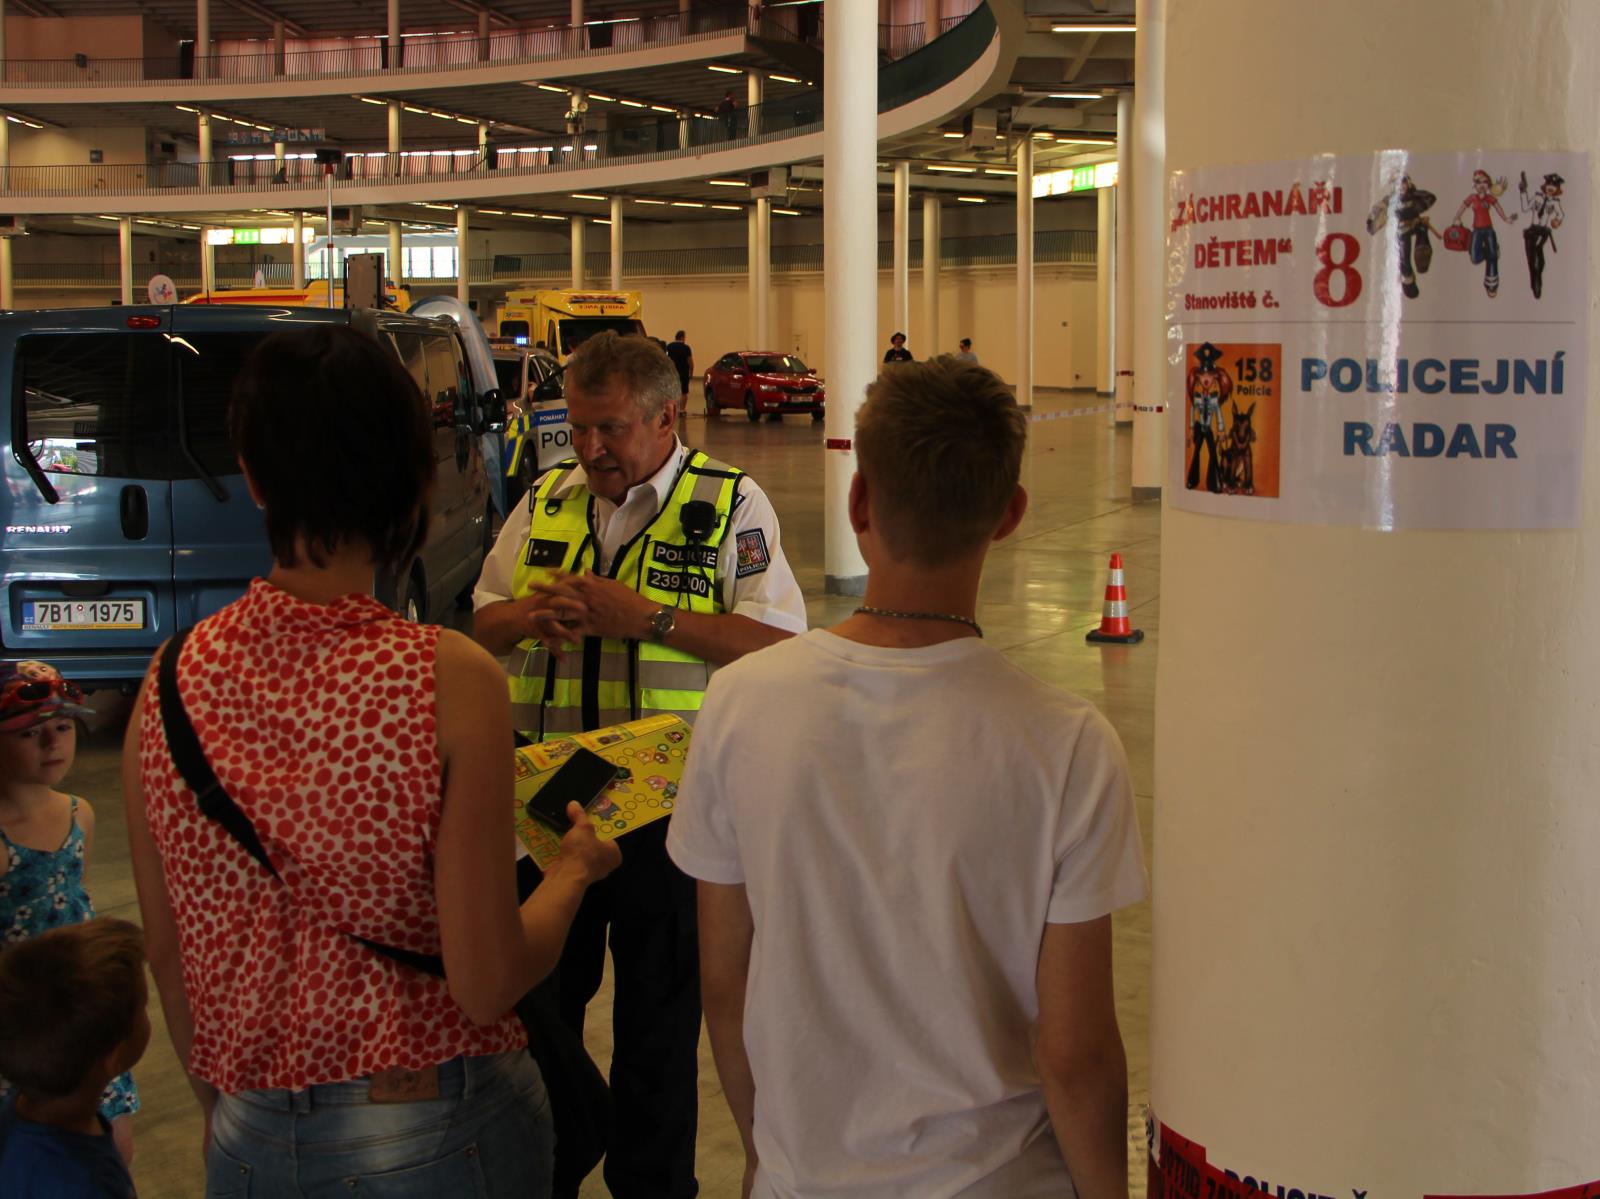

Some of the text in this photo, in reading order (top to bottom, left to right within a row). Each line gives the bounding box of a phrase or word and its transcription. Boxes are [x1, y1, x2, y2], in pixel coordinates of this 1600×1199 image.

[1313, 232, 1362, 308] 8
[1184, 290, 1280, 311] Stanoviště č.
[1235, 358, 1273, 382] 158
[1300, 351, 1566, 396] POLICEJNÍ
[1236, 384, 1272, 396] Policie
[1342, 422, 1518, 459] RADAR
[5, 525, 72, 535] RENAULT
[651, 571, 707, 594] 23900
[38, 603, 134, 623] 7B1 1975
